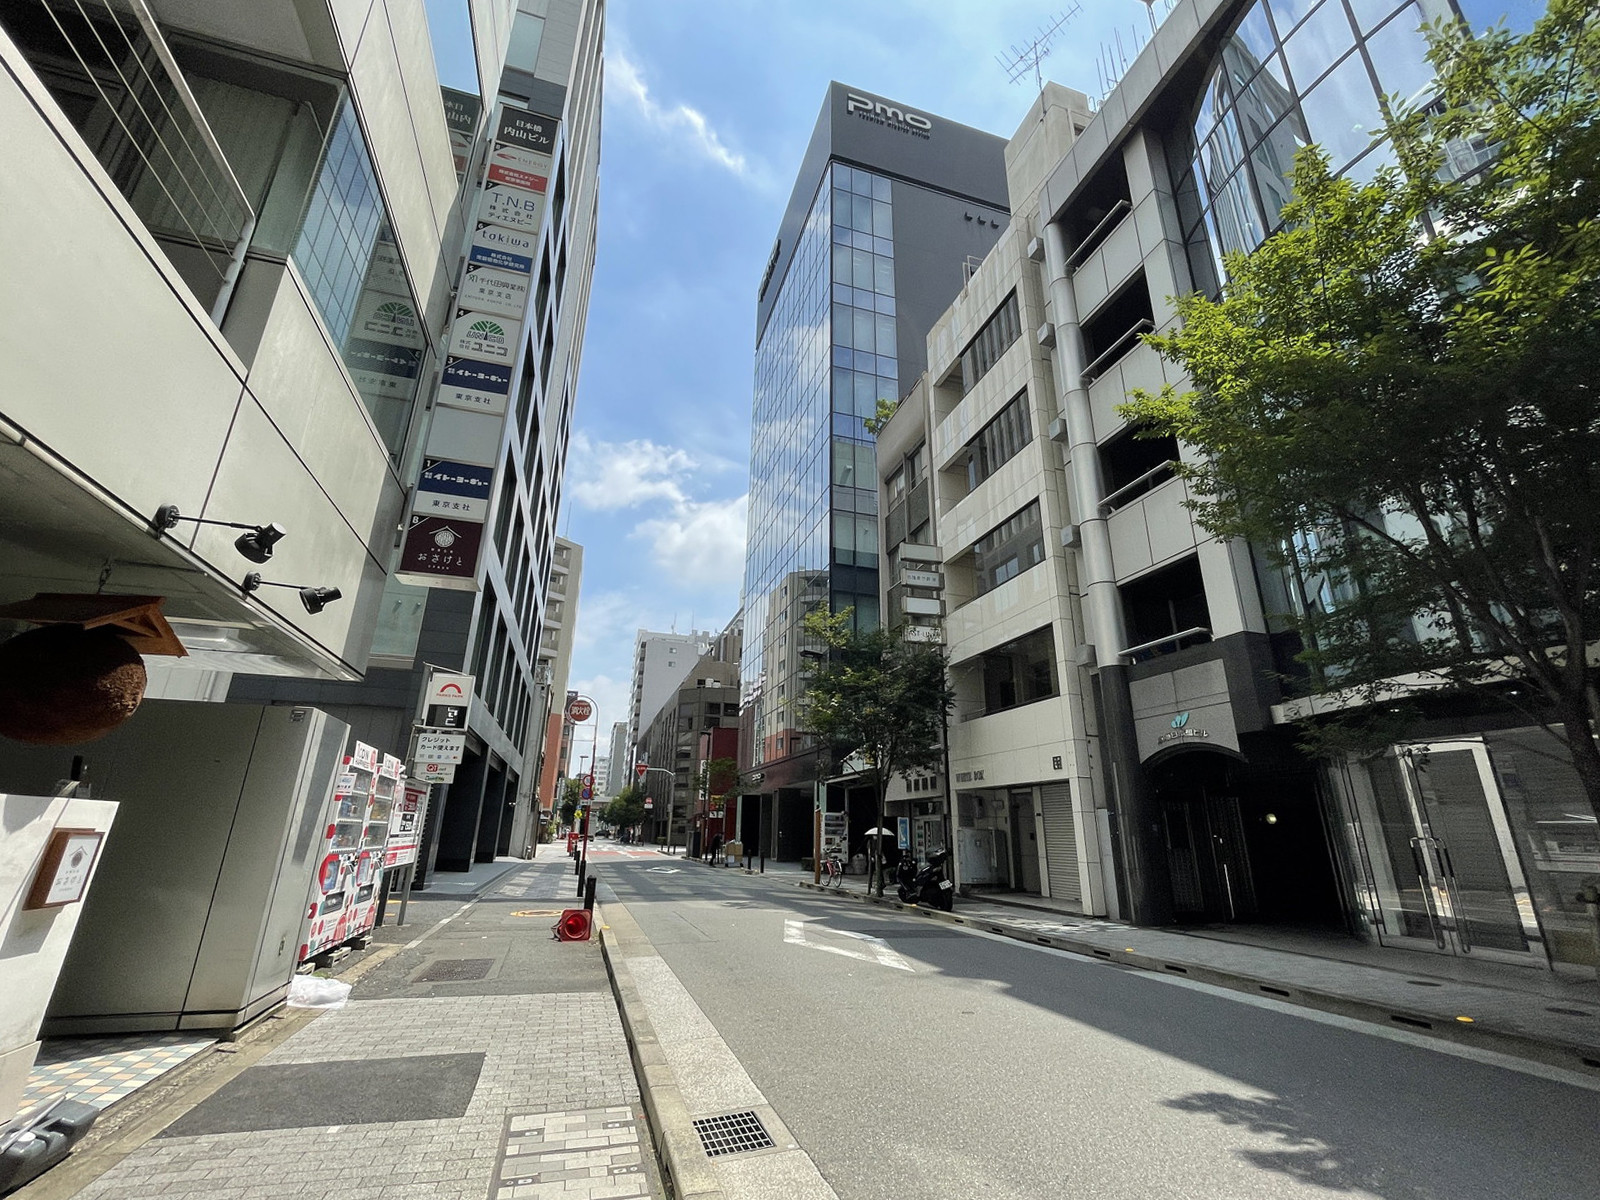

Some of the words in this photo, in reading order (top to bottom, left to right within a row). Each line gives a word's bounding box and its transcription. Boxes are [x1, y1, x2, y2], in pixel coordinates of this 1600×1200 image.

[516, 119, 543, 132] 日本橋
[504, 126, 550, 144] 内山ビル
[492, 191, 535, 211] T.N.B
[482, 230, 530, 248] tokiwa
[472, 341, 508, 357] ユニコ
[455, 393, 491, 405] 東京支社
[431, 500, 471, 512] 東京支社
[418, 553, 462, 566] おさけと
[570, 706, 591, 716] 消火栓
[420, 744, 460, 752] カード使えます
